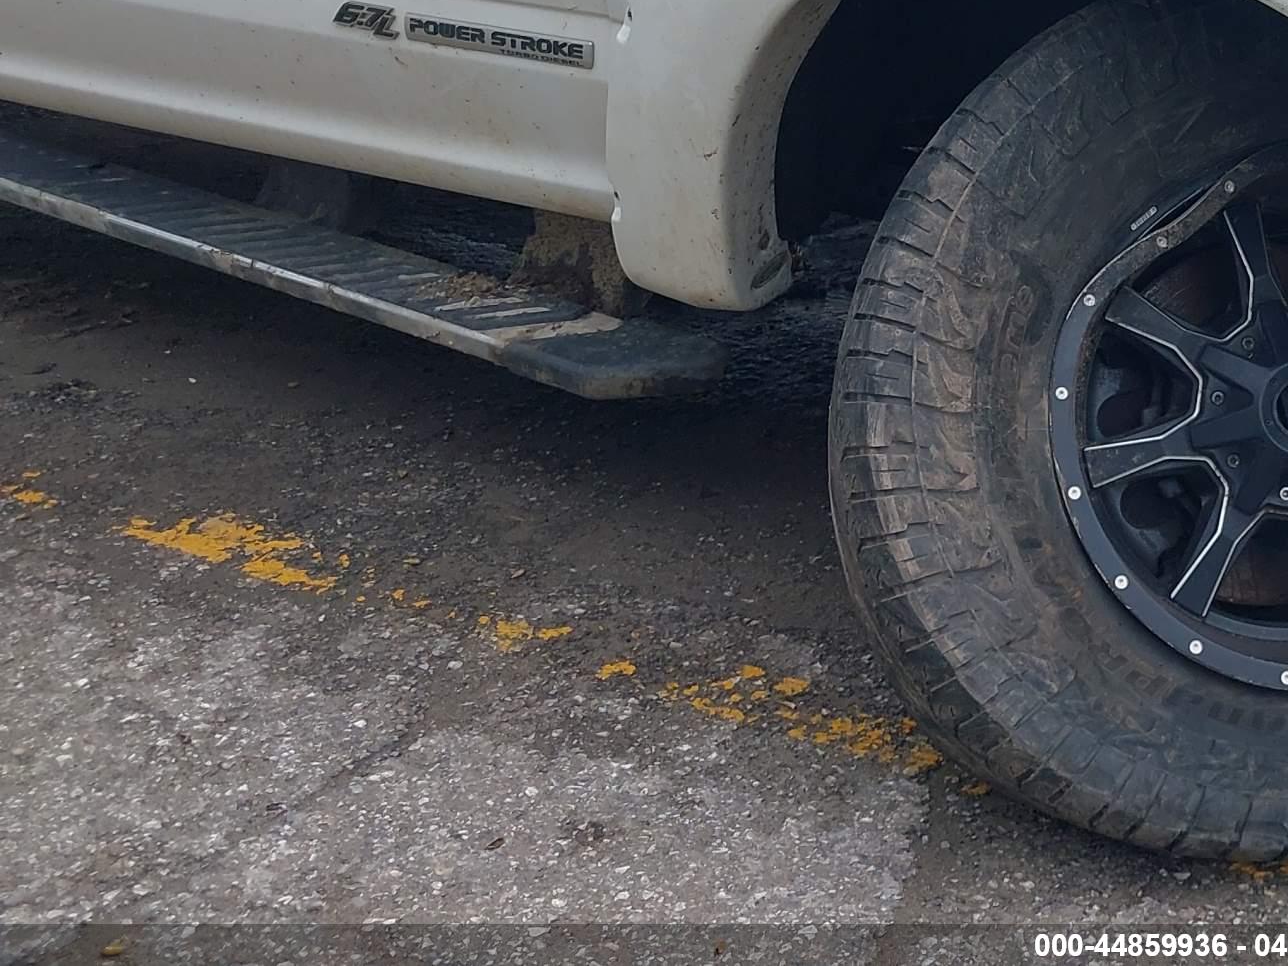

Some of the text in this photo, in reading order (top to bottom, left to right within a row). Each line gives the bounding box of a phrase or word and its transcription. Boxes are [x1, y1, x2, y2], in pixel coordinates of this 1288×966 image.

[333, 0, 400, 40] 6.7L
[409, 17, 584, 60] POWER STROKE
